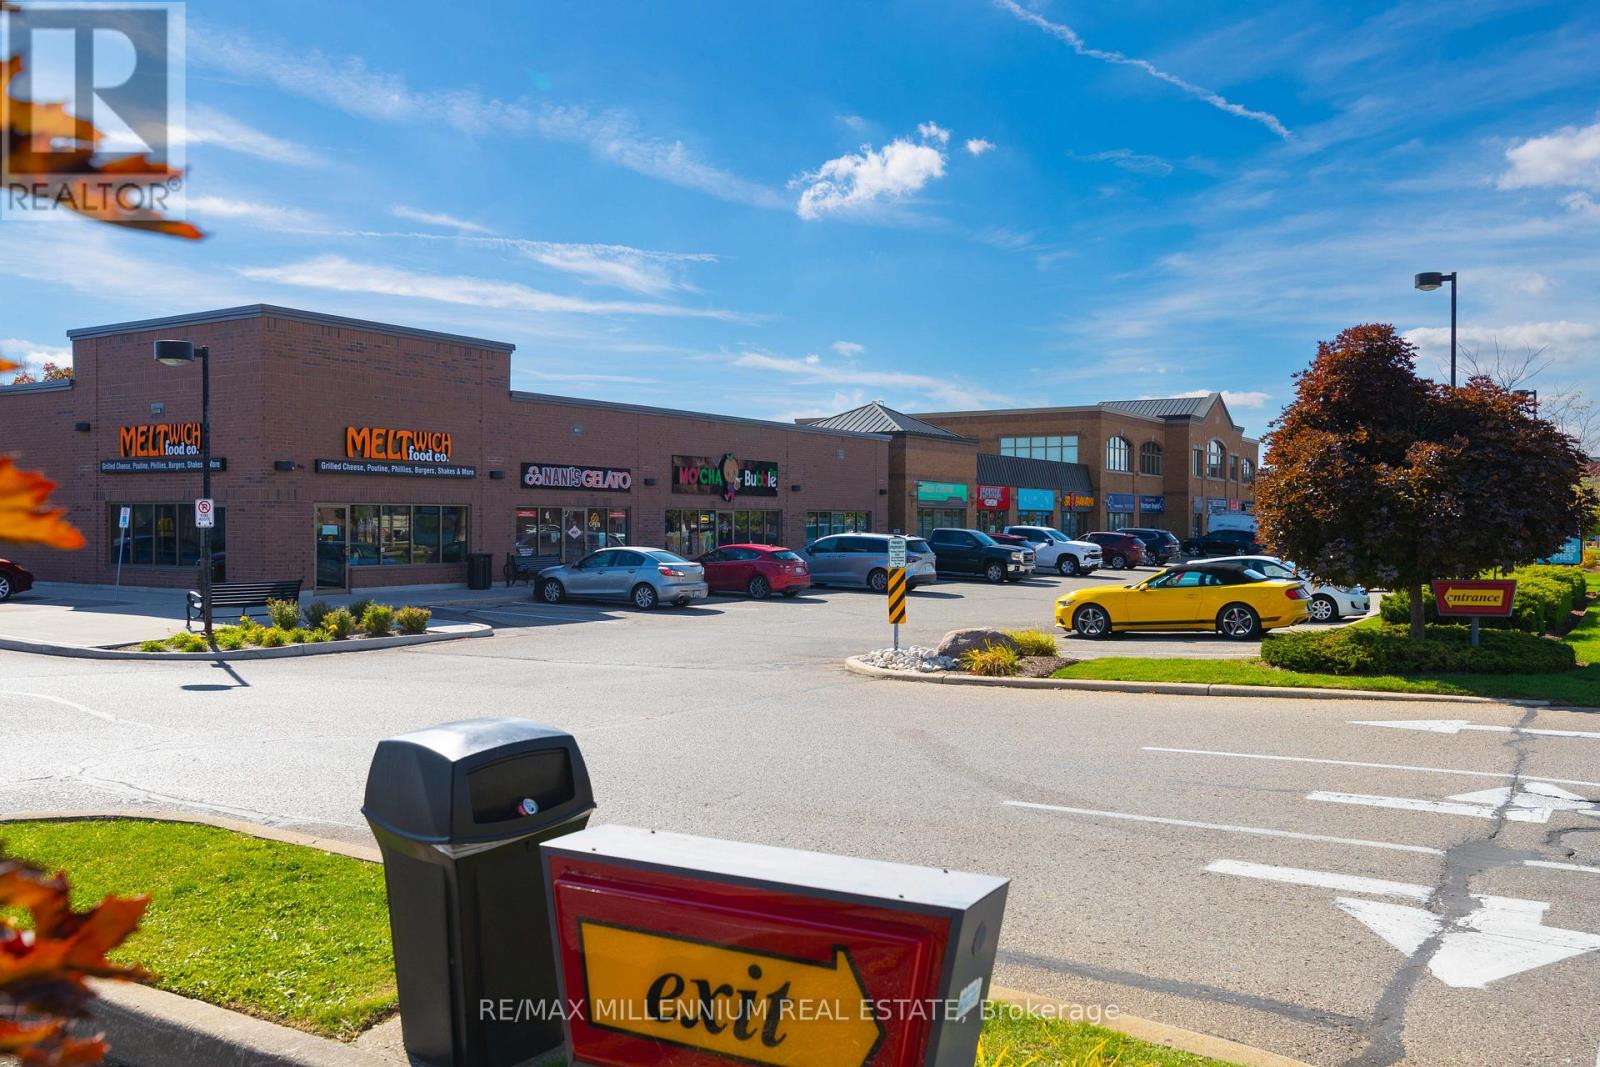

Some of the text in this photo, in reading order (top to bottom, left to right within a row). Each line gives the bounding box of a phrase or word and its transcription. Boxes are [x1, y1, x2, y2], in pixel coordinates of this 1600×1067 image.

[165, 440, 200, 455] food co.
[408, 446, 450, 463] food co.
[321, 461, 341, 470] Grilled
[342, 463, 366, 472] Cheese,
[367, 464, 390, 473] Poutine,
[414, 466, 436, 475] Burgers,
[437, 467, 455, 475] Shakes
[461, 468, 474, 476] More
[541, 466, 632, 489] NANI'S GELATO
[744, 470, 777, 488] Bubble
[1447, 592, 1500, 602] entrance
[646, 964, 795, 1048] exit
